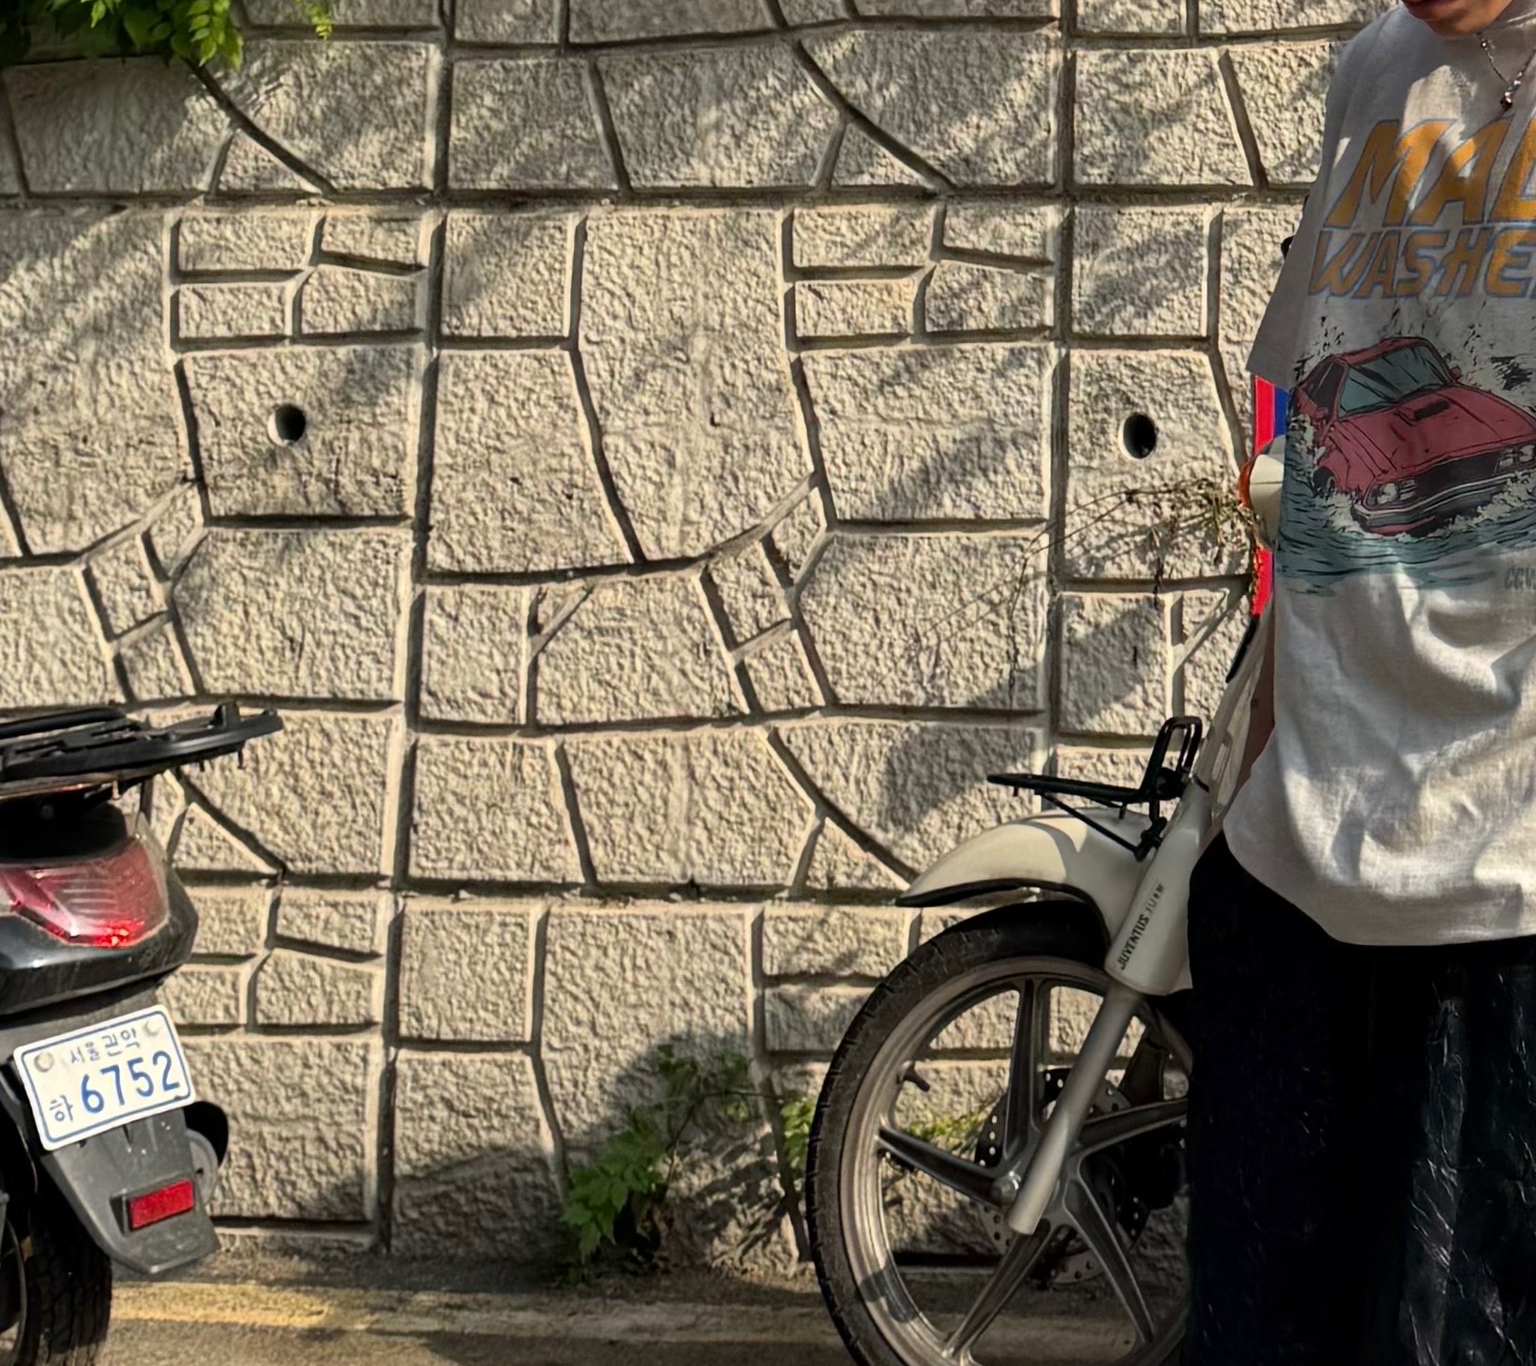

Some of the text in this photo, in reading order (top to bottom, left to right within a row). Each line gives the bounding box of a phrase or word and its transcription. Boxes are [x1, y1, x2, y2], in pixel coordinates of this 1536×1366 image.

[1117, 914, 1150, 971] JUVENTUS
[49, 1050, 181, 1123] 하 6752
